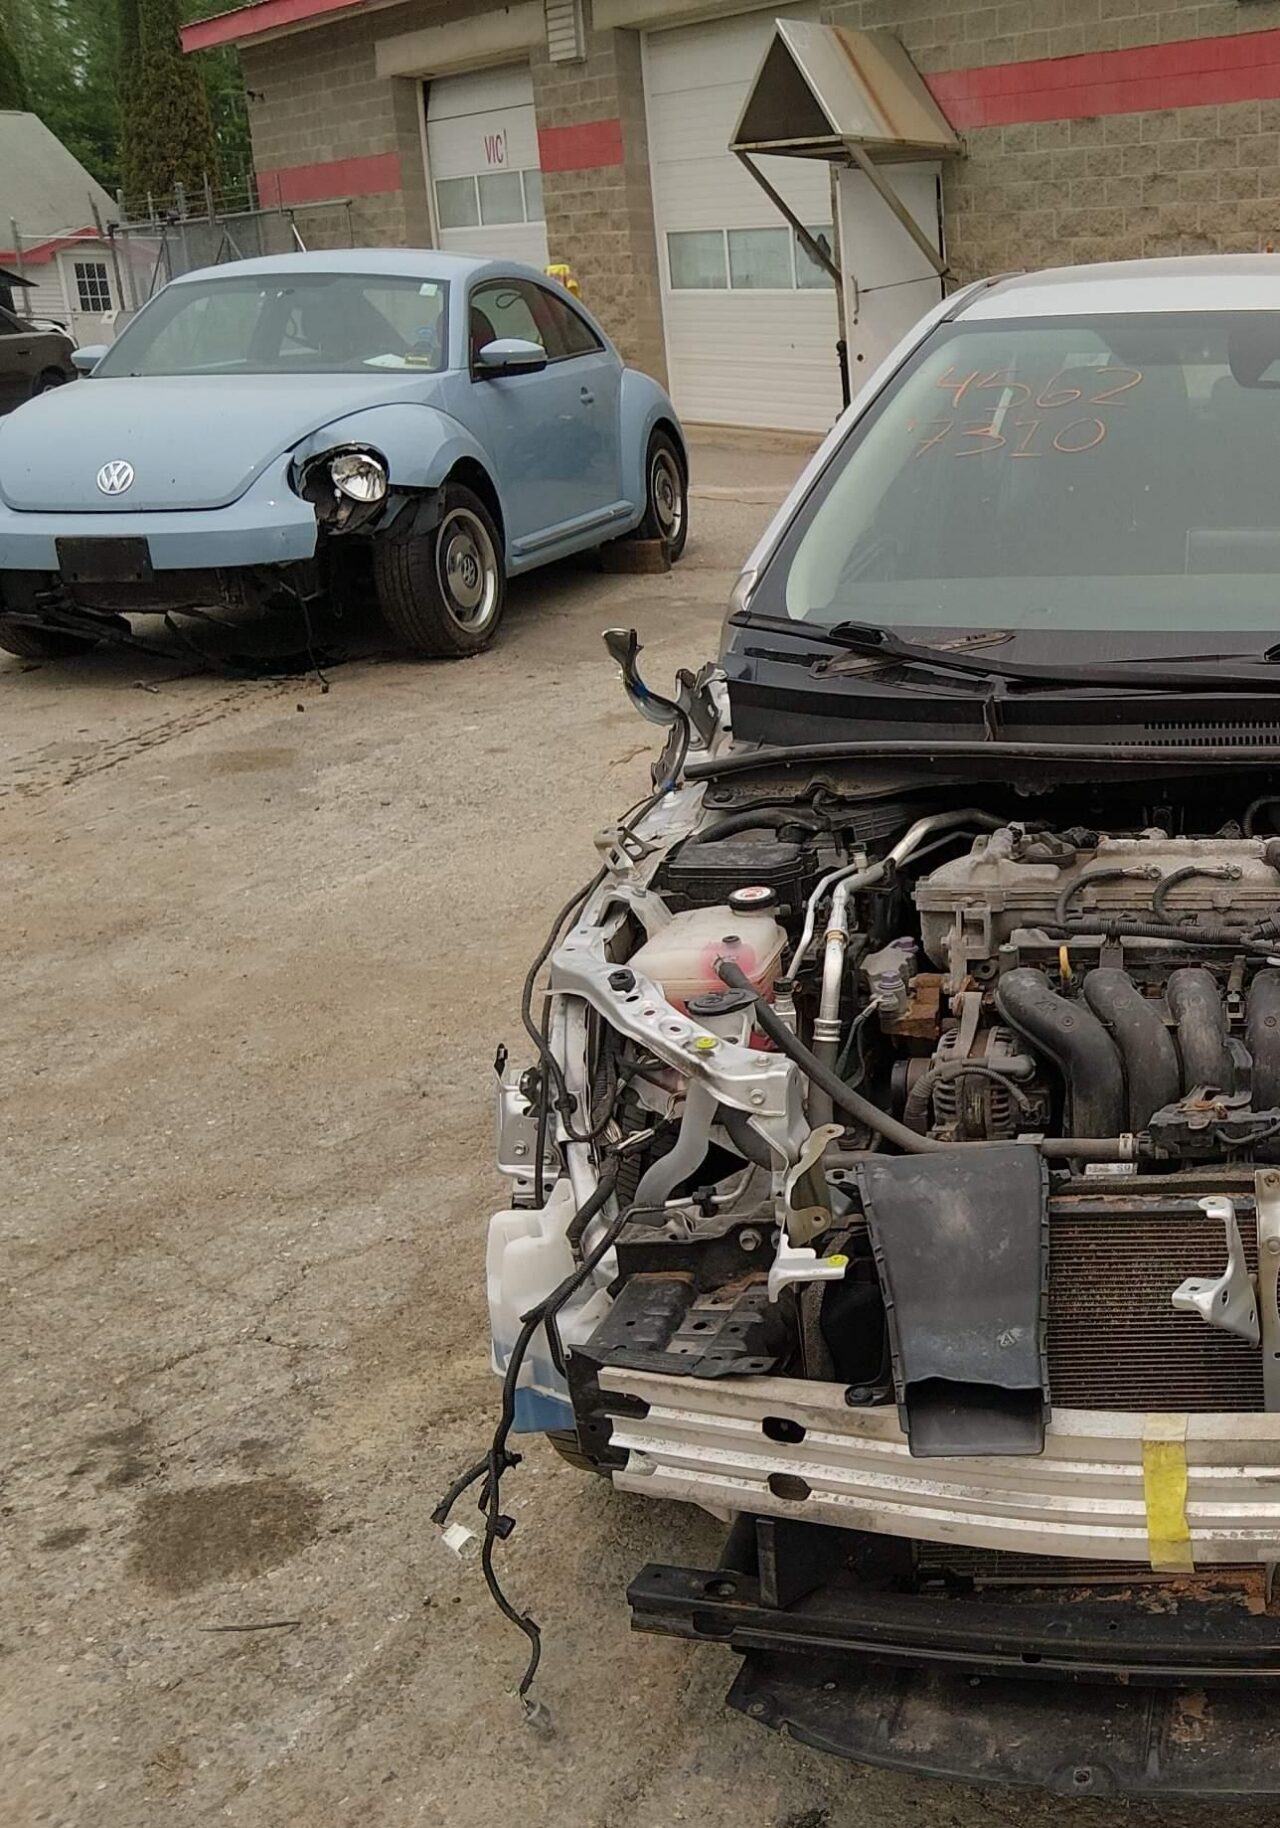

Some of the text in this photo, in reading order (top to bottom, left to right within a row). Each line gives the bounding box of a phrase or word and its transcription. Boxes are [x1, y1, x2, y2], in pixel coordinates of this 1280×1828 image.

[936, 367, 1142, 411] 4562
[916, 417, 1106, 458] 7310
[97, 460, 134, 494] VW
